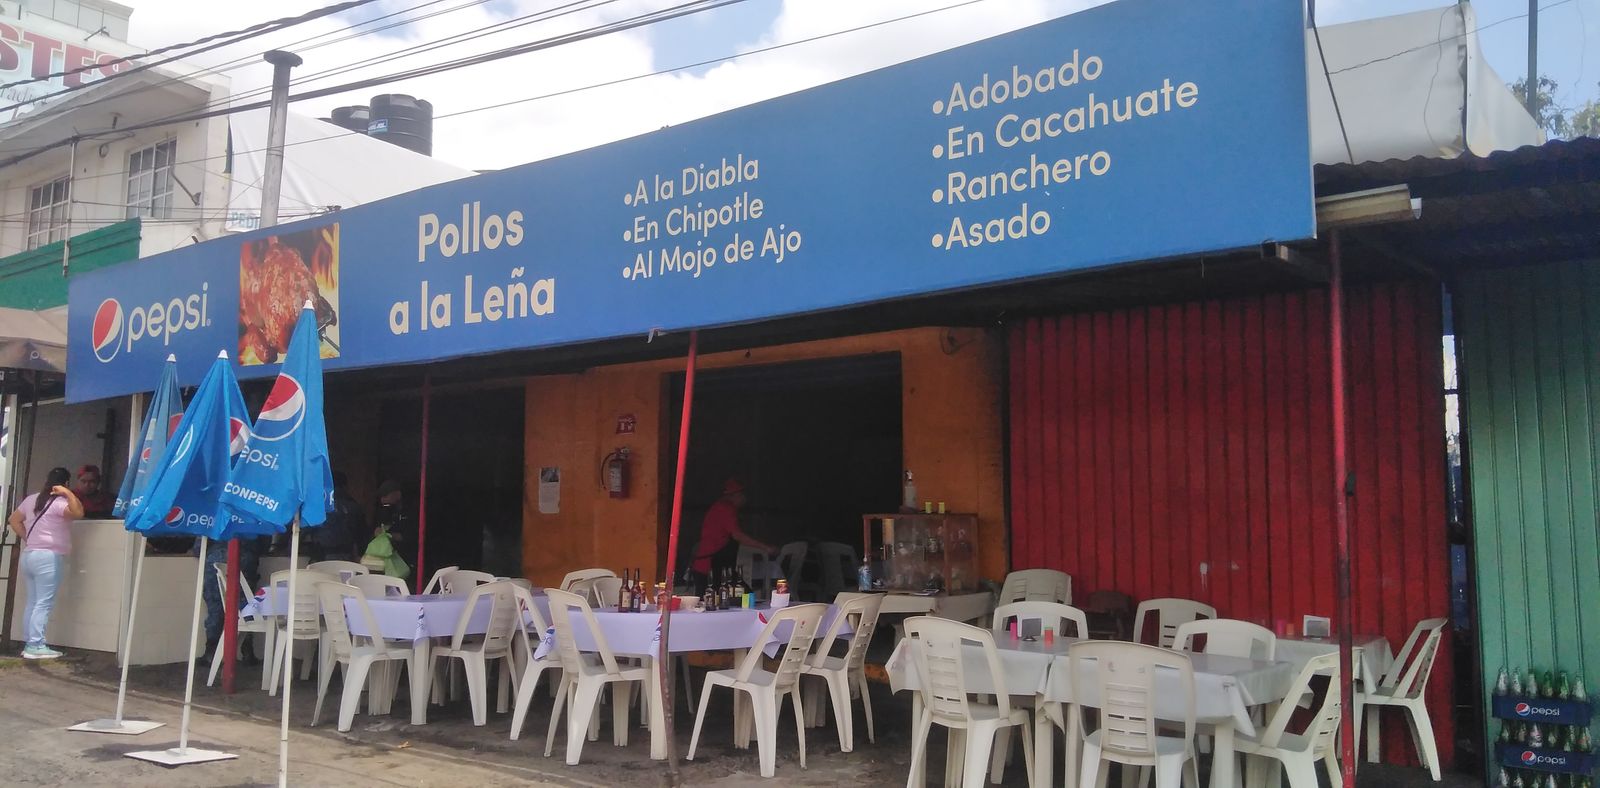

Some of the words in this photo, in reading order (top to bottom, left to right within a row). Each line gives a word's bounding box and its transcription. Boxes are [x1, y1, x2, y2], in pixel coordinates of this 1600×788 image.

[945, 49, 1103, 116] Adobado
[948, 126, 984, 160] En
[995, 78, 1199, 148] Cacahuate
[633, 179, 649, 207] A
[655, 174, 674, 202] la
[682, 153, 759, 196] Diabla
[947, 150, 1111, 205] Ranchero
[418, 201, 524, 263] Pollos
[633, 215, 659, 243] En
[666, 191, 764, 237] Chipotle
[945, 202, 1051, 250] Asado
[631, 250, 653, 280] Al
[660, 240, 717, 278] Mojo
[724, 233, 754, 263] de
[760, 224, 801, 263] Ajo
[127, 281, 209, 353] pepsi
[389, 301, 409, 335] a
[421, 280, 451, 331] la
[464, 266, 555, 324] Leña
[1531, 706, 1560, 716] pepsi
